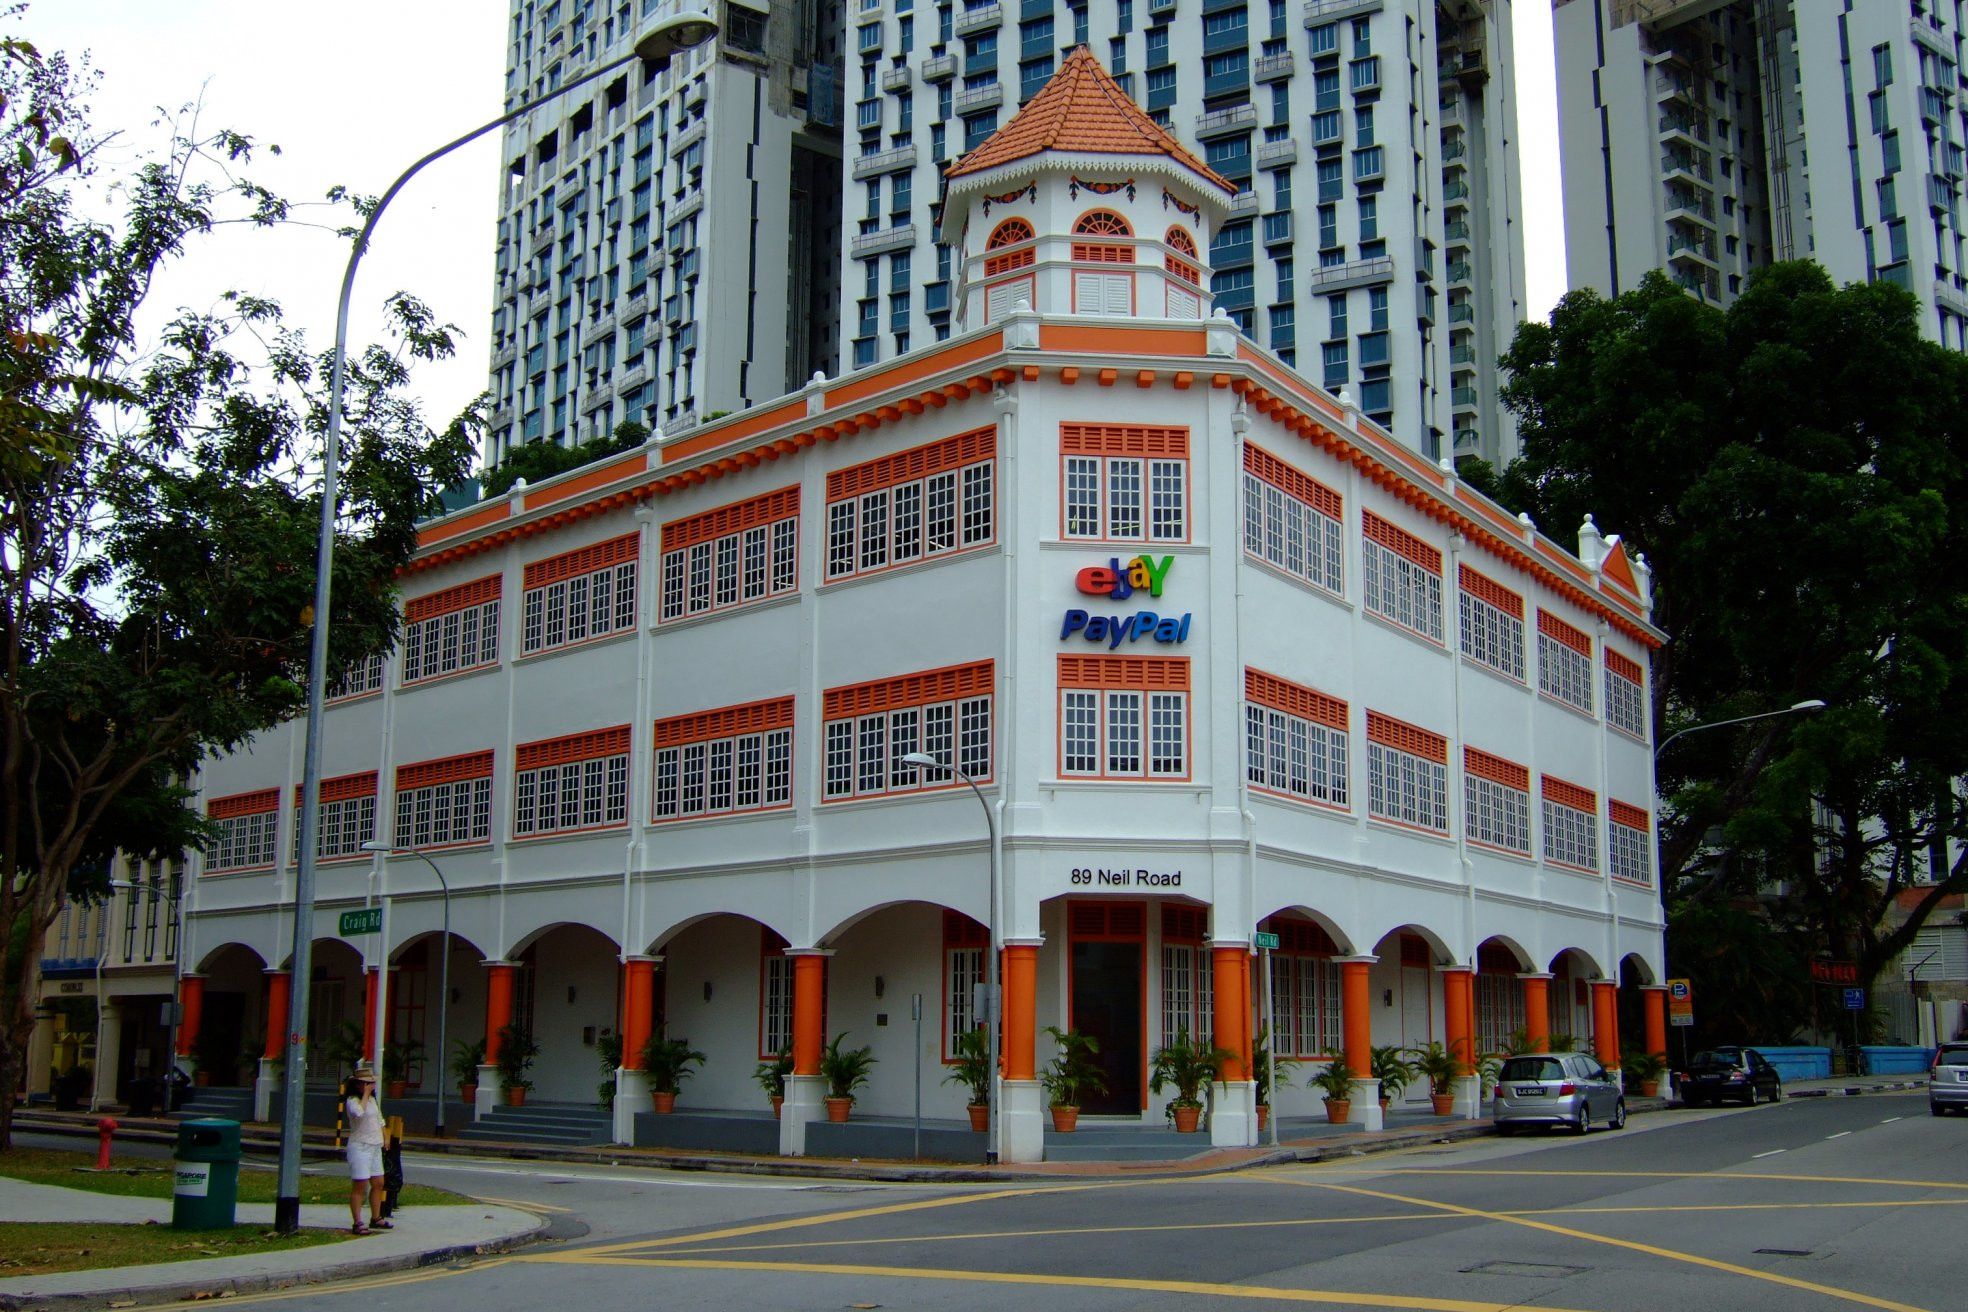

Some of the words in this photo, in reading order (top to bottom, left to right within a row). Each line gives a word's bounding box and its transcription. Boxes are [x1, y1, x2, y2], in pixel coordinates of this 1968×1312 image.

[1060, 609, 1191, 649] PayPal
[1071, 868, 1091, 884] 89
[1098, 869, 1130, 884] Neil
[1136, 870, 1181, 886] Road
[343, 914, 366, 931] Craig
[370, 911, 381, 926] Rd
